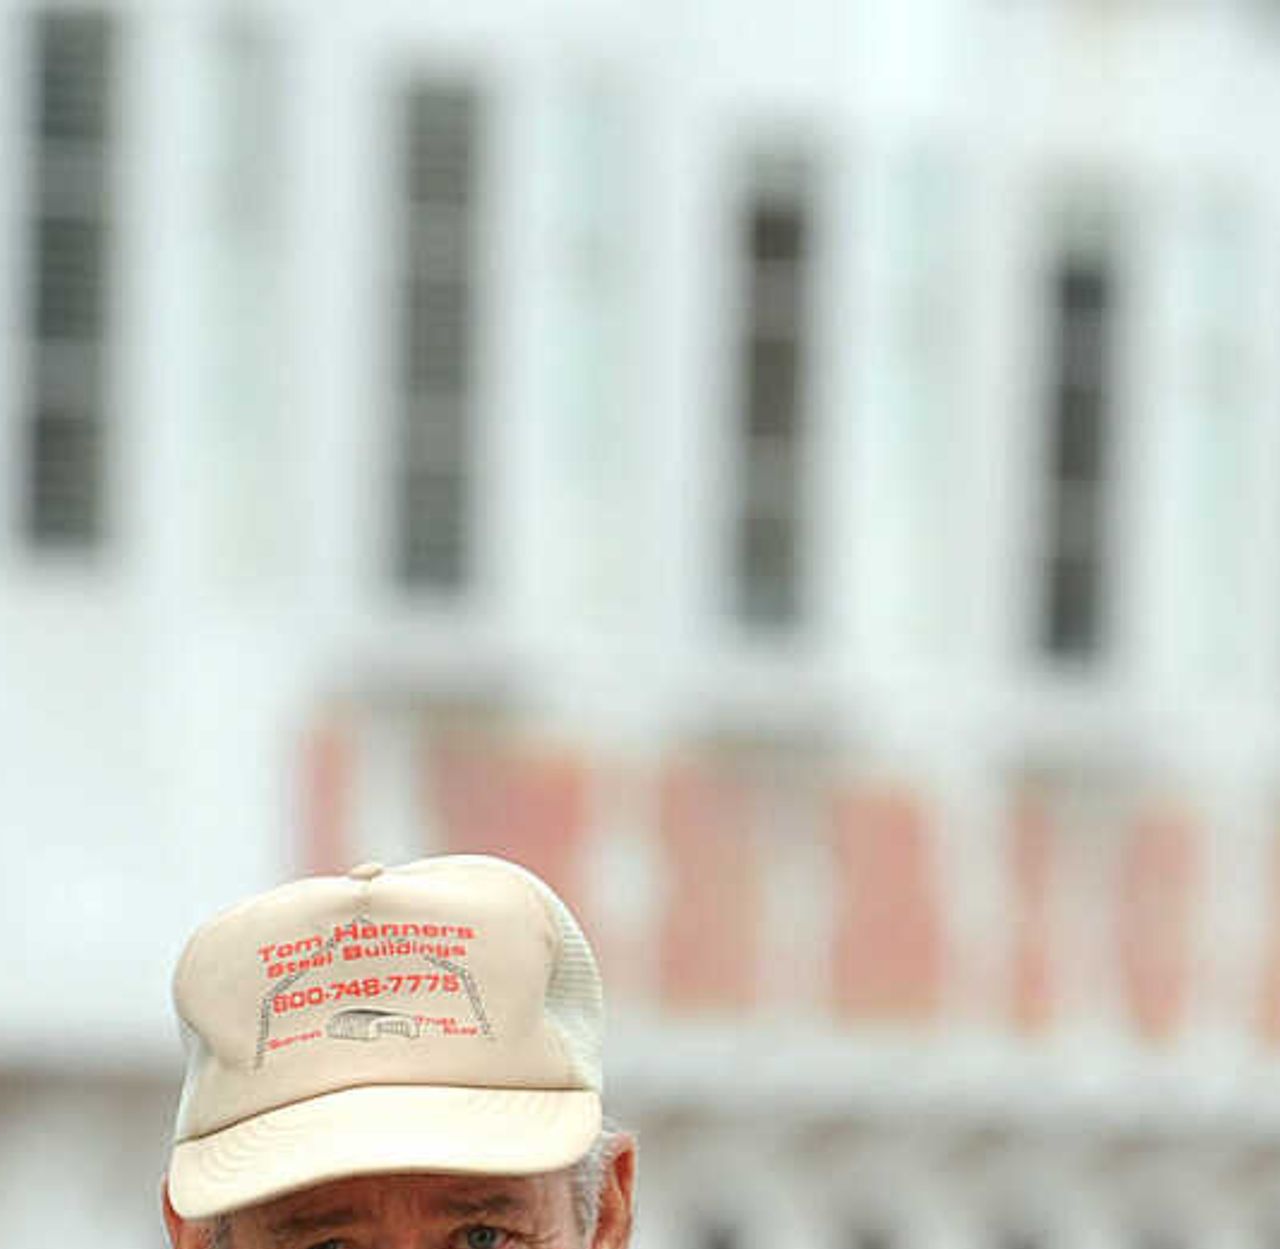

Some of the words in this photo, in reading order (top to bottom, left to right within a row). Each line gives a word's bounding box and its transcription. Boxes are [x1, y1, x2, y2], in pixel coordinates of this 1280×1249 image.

[258, 935, 324, 963] Tom
[334, 922, 476, 943] Hanners
[266, 951, 334, 979] Steel
[342, 939, 467, 962] Buildings
[272, 973, 461, 1014] 800-748-7775
